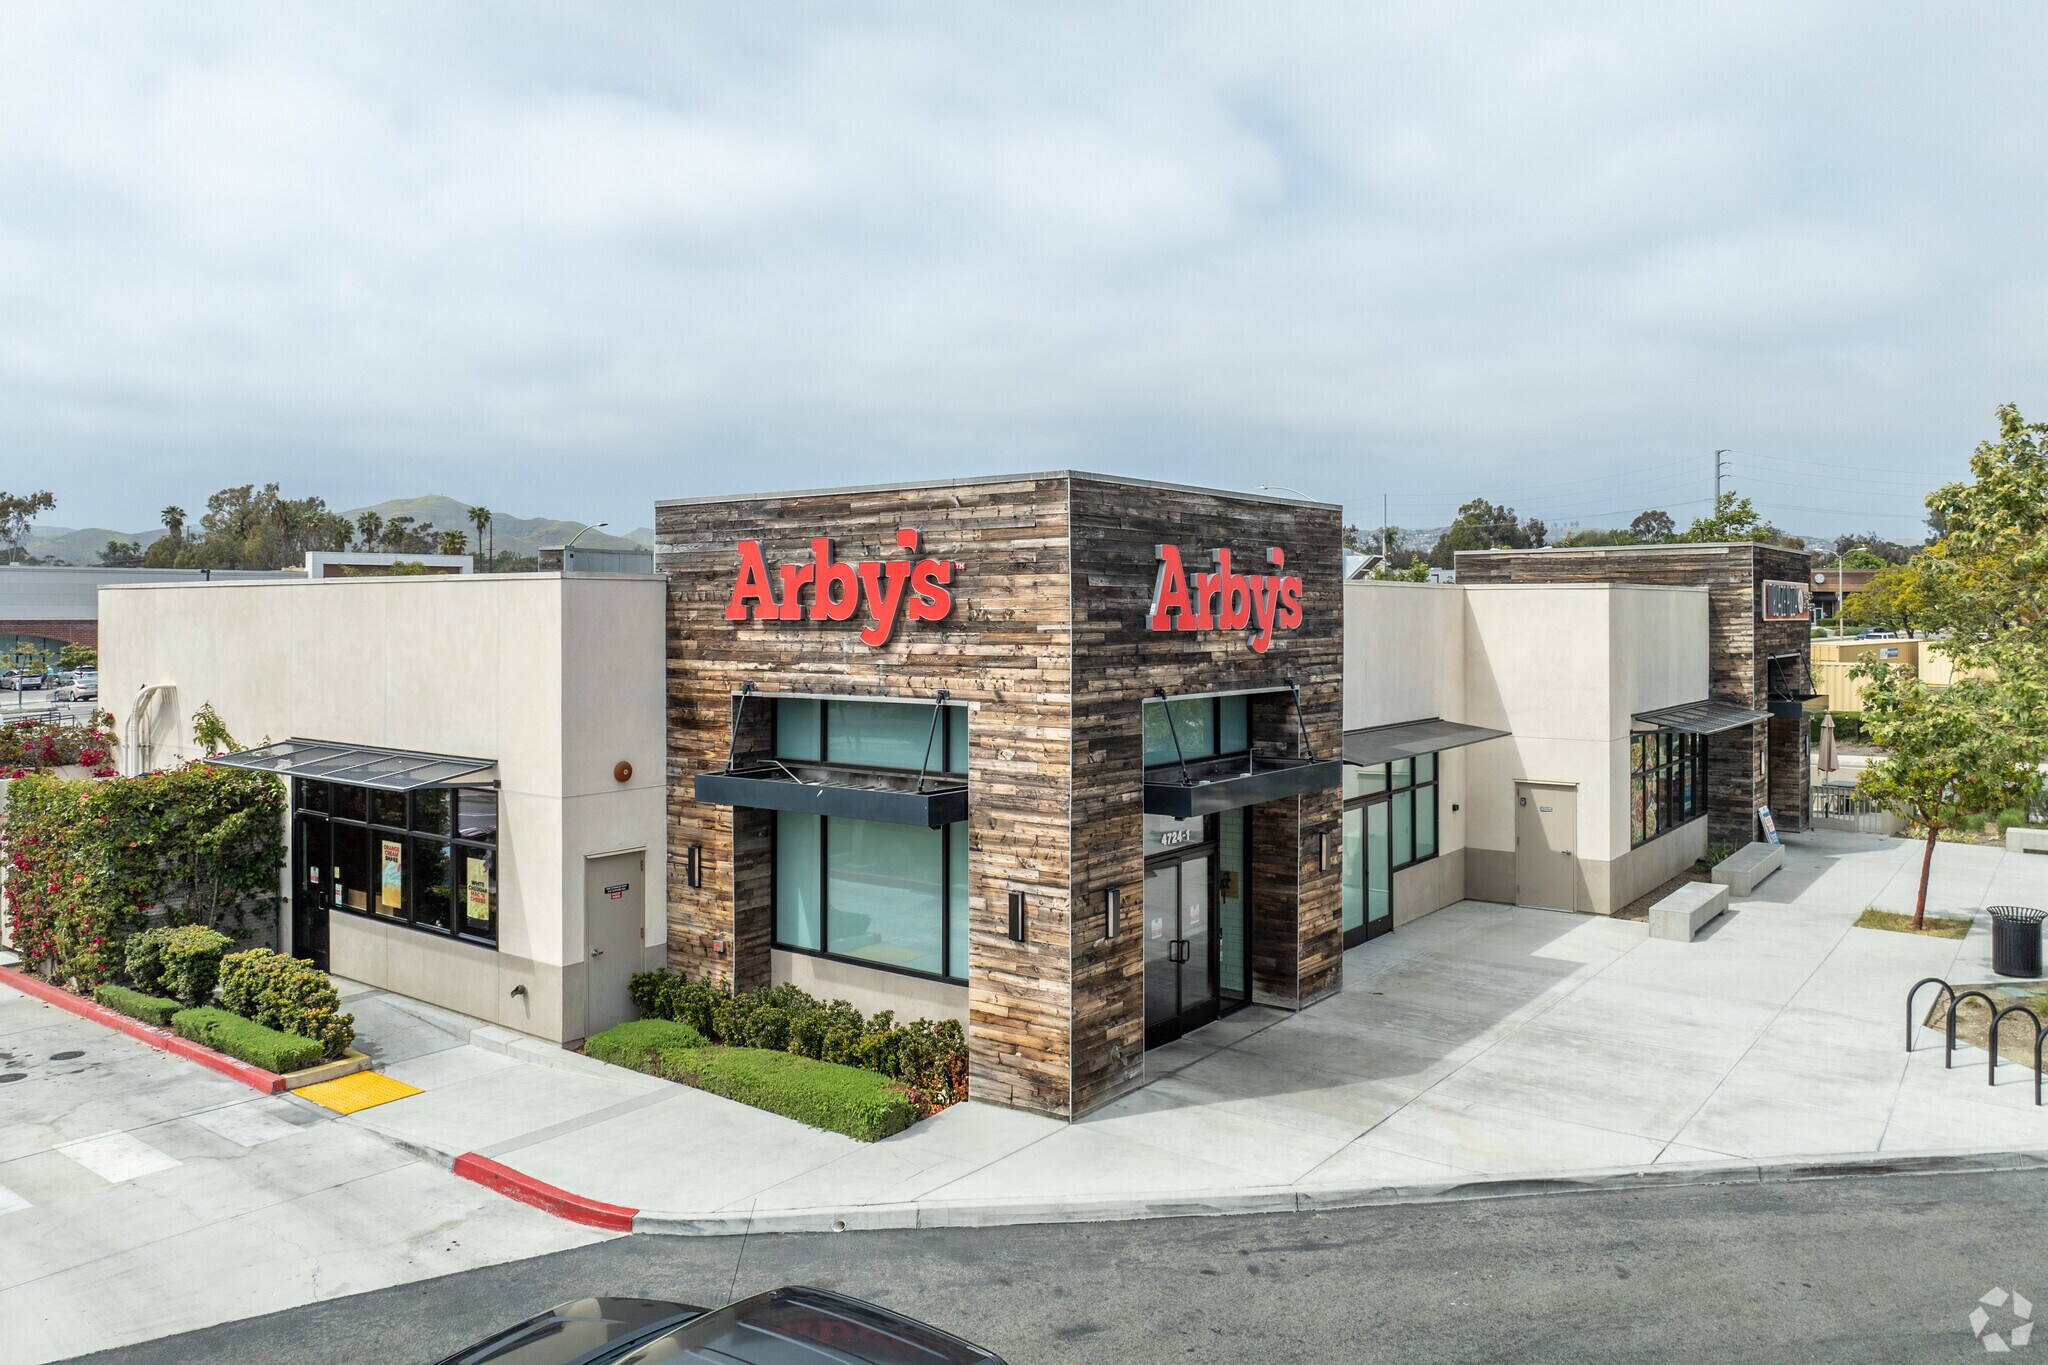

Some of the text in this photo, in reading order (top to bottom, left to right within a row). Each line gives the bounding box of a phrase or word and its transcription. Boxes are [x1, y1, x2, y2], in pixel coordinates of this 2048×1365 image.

[725, 528, 954, 647] Arby's
[1147, 544, 1303, 654] Arby's
[1161, 829, 1190, 846] 4724-1
[384, 844, 400, 853] ORANGE
[385, 855, 399, 863] SHAKE
[468, 885, 488, 893] CHEDDAR
[470, 896, 486, 904] CHEESE
